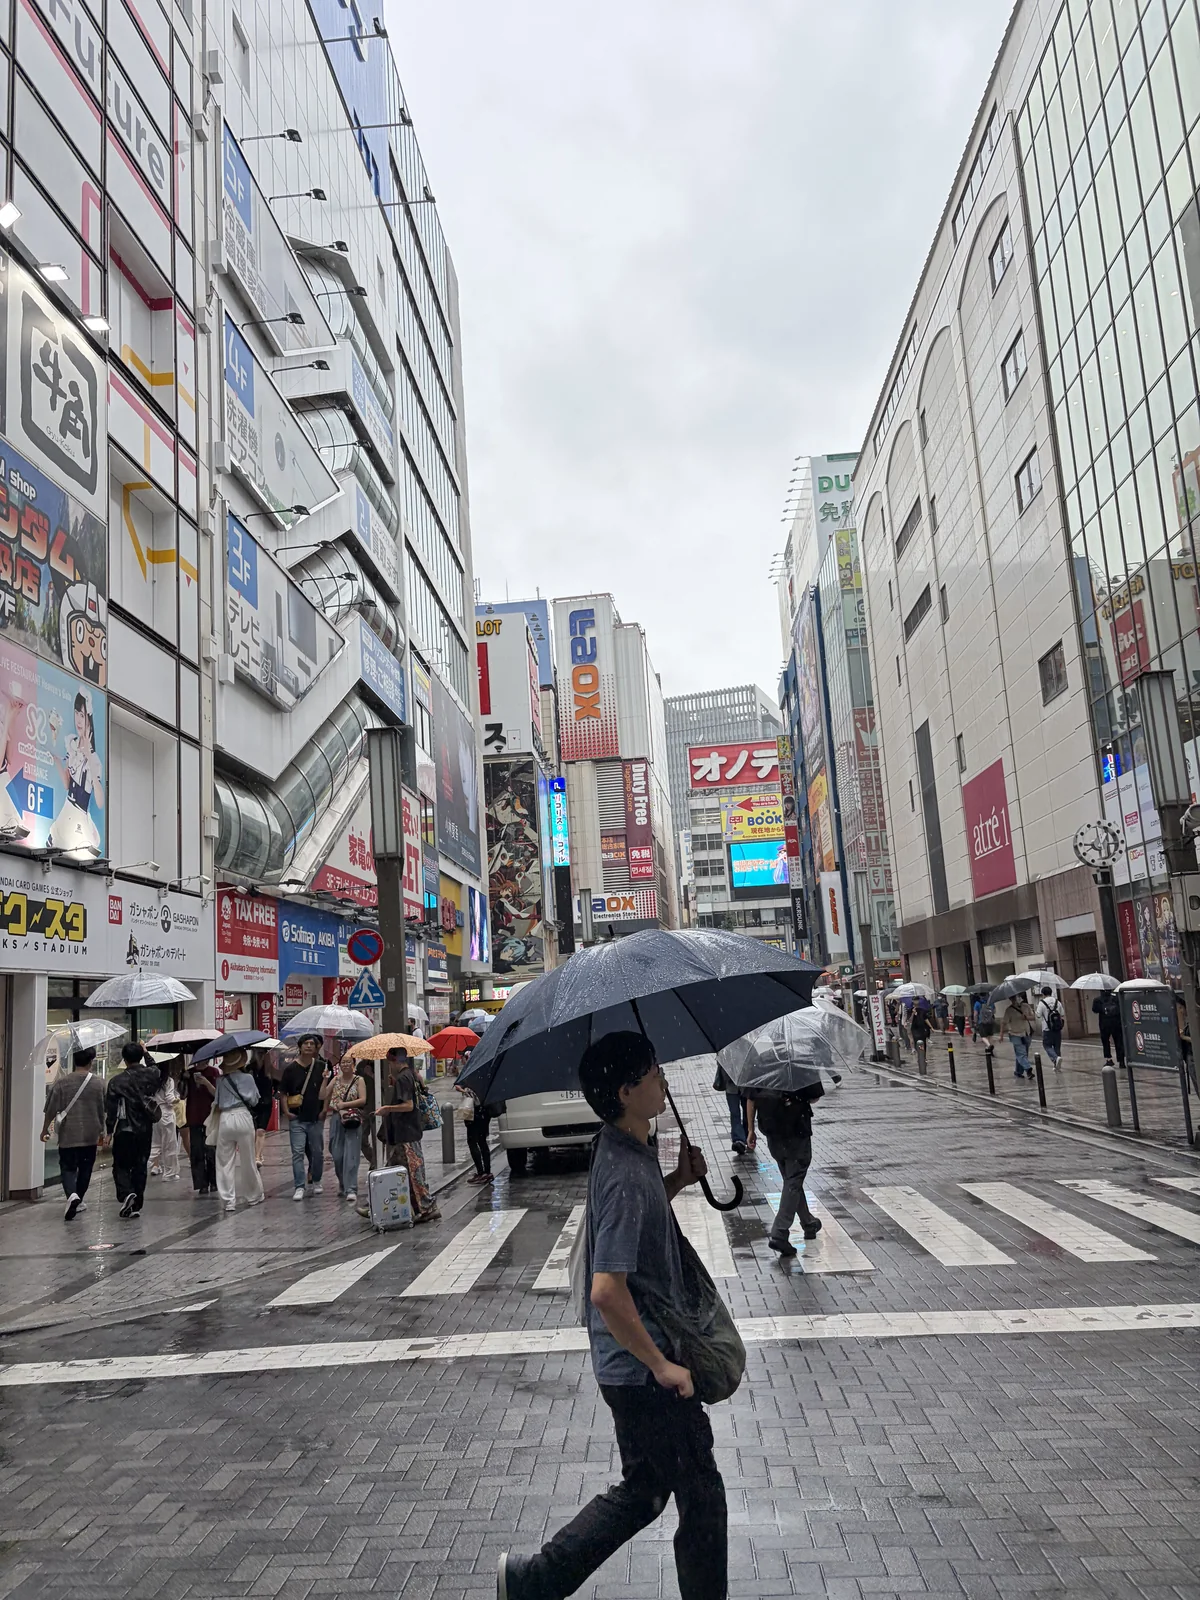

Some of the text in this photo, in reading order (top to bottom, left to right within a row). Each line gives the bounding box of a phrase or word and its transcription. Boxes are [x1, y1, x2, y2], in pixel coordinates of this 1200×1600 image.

[226, 136, 245, 203] 5F
[228, 331, 248, 391] 4F
[228, 429, 267, 490] エアコン
[9, 470, 37, 501] shop
[232, 526, 251, 586] 3F
[229, 597, 260, 647] テレビ
[27, 783, 44, 812] 6F
[632, 763, 648, 826] Duty Free
[747, 815, 783, 827] BOOK
[973, 805, 1002, 856] atré
[16, 879, 30, 891] CARD
[32, 883, 49, 894] GAMES
[110, 899, 122, 910] BAN
[110, 910, 120, 920] DAI
[130, 902, 159, 919] ガシャポン
[234, 898, 276, 927] TAX FREE
[577, 896, 636, 914] aox
[593, 909, 636, 919] Electronics Store
[173, 912, 199, 926] GASHAPON
[34, 941, 88, 956] STADIUM
[291, 923, 316, 949] Sofmap
[318, 931, 336, 948] AKIBA
[140, 944, 186, 961] ガシャポンのデパート
